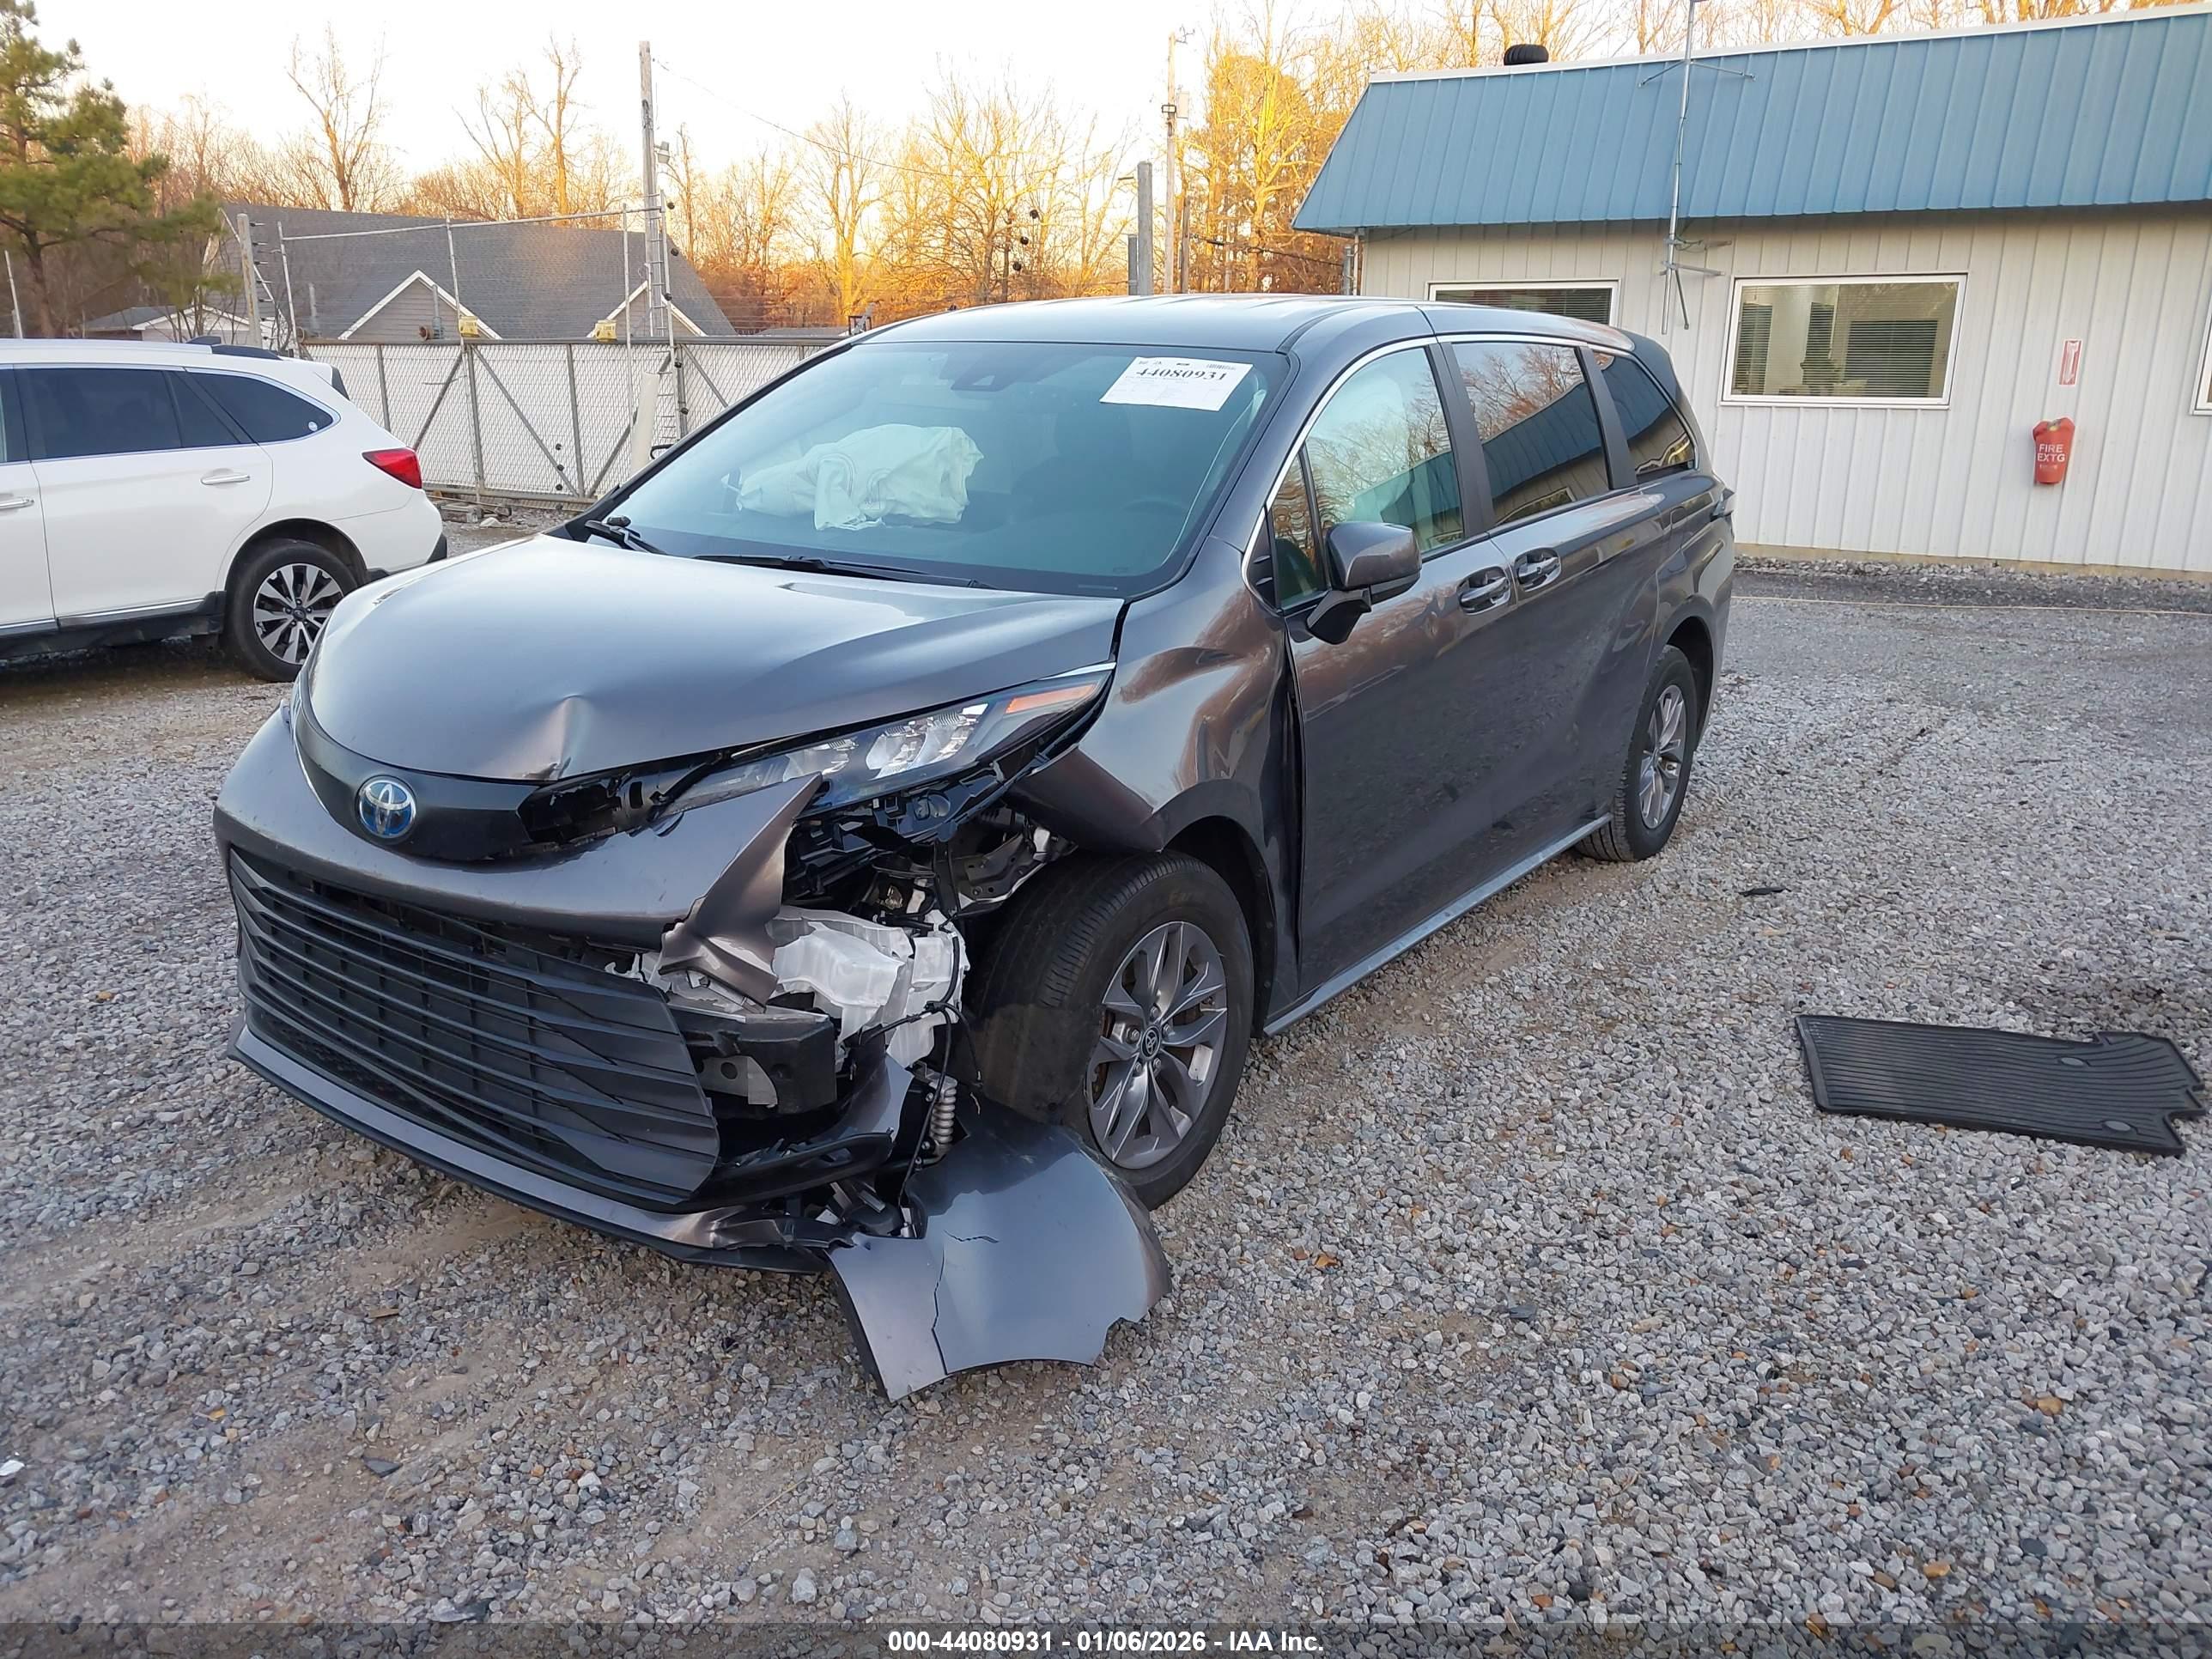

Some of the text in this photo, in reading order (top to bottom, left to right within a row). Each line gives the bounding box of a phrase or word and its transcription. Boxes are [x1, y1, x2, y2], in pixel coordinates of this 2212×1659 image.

[1136, 368, 1227, 380] 44080931
[2039, 443, 2063, 453] FIRE
[2037, 453, 2065, 462] EXTG
